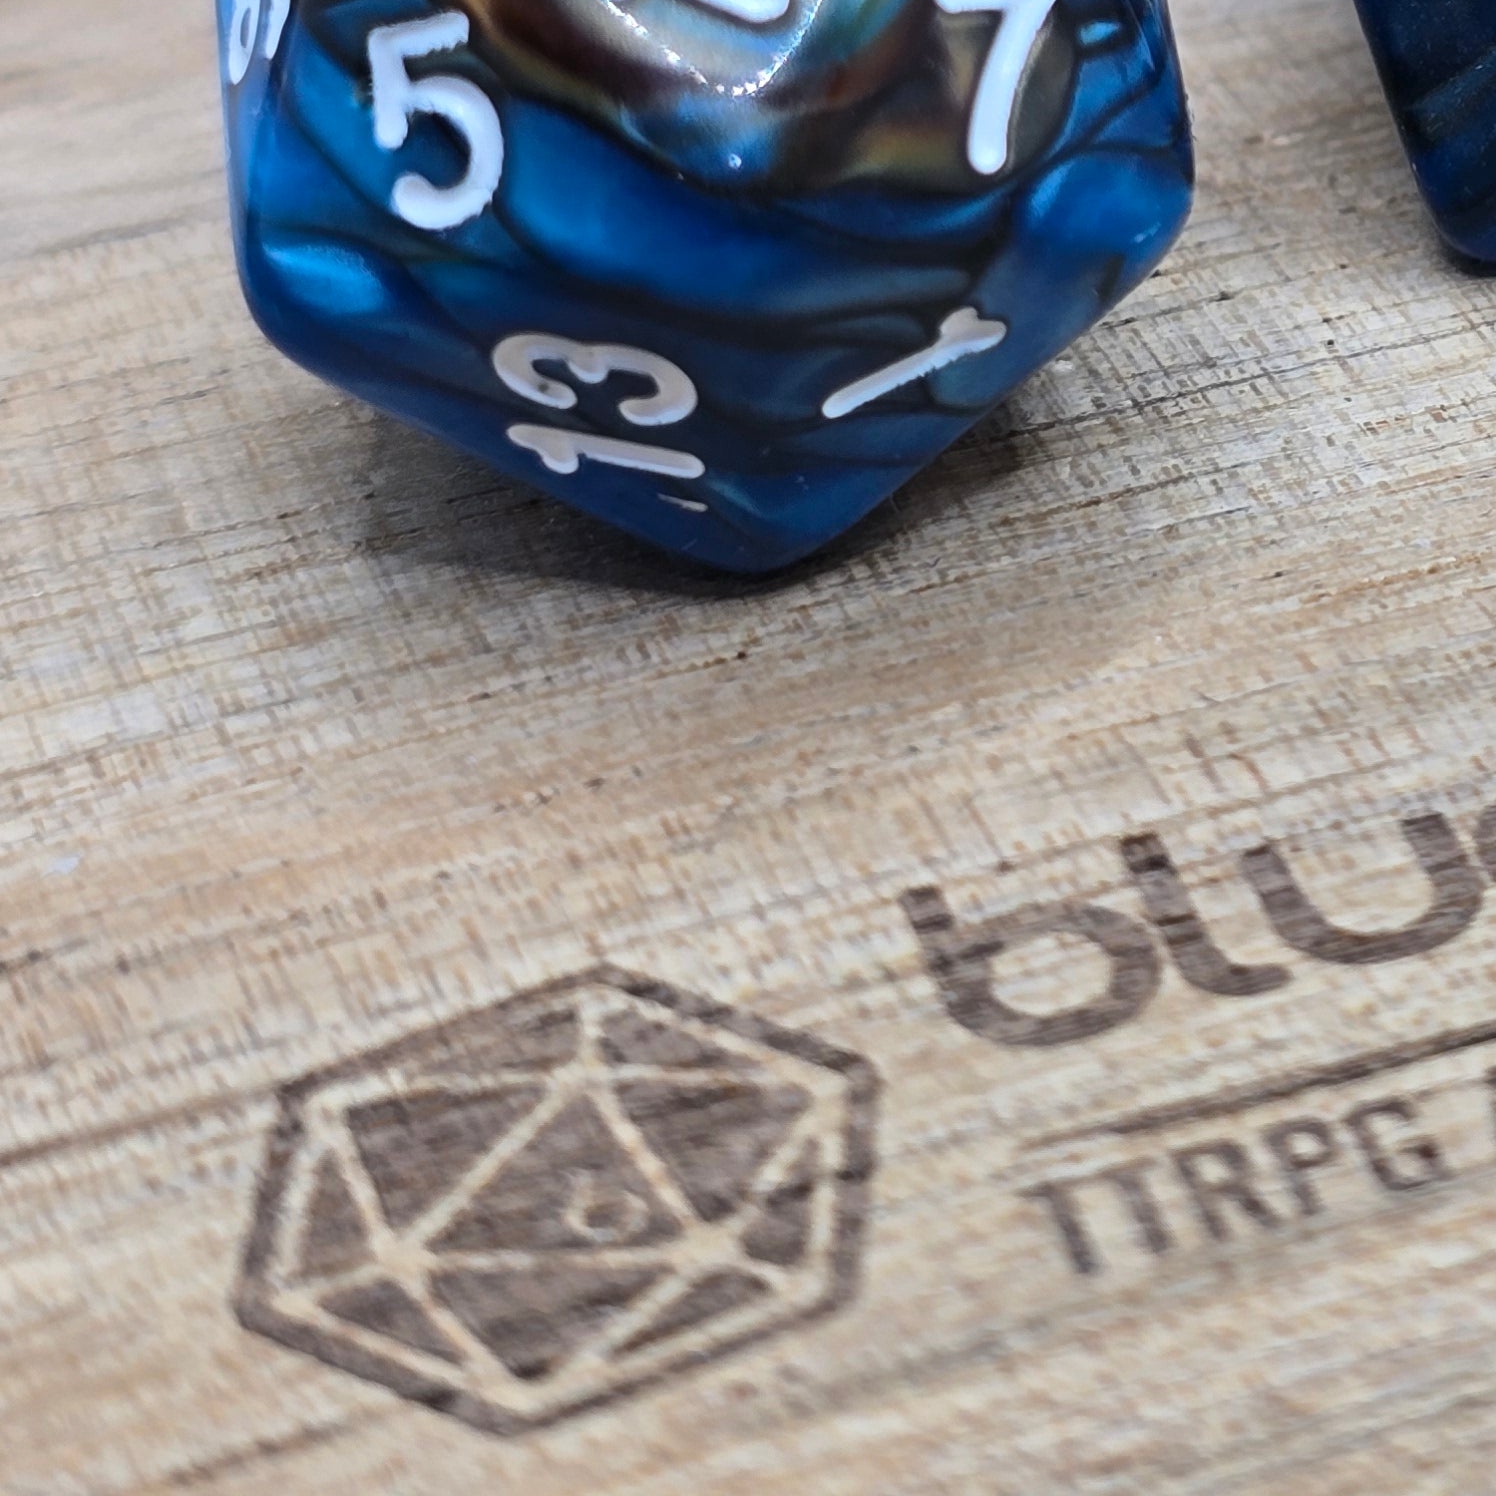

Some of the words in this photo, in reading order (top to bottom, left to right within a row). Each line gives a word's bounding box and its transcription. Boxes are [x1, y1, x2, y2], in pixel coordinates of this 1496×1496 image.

[366, 11, 505, 231] 5
[492, 330, 706, 480] 13
[820, 306, 1008, 420] 1
[1020, 1094, 1451, 1278] TTRPG
